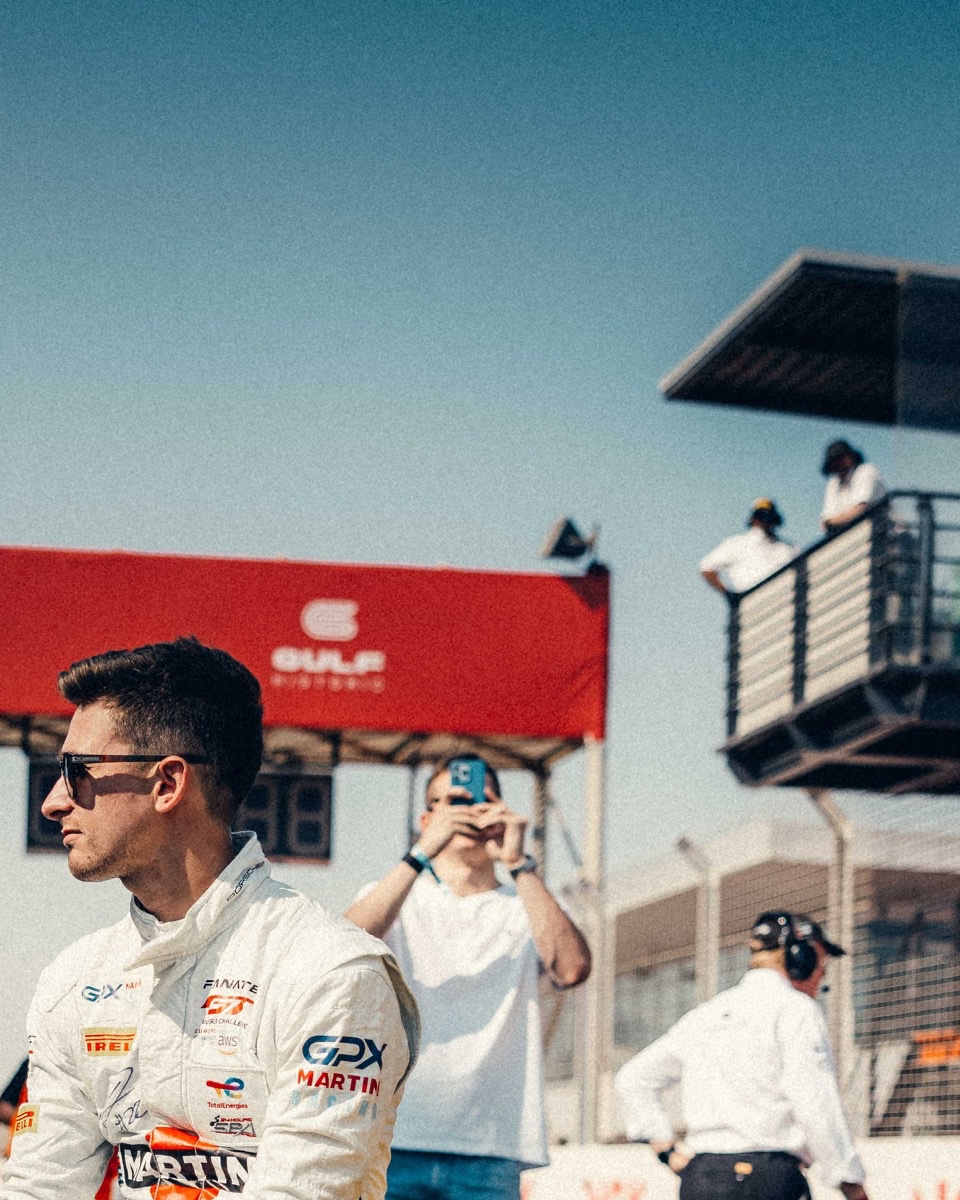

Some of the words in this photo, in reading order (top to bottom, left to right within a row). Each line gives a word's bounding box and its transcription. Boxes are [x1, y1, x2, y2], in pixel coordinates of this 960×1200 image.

[82, 984, 123, 1003] GX
[217, 1035, 239, 1047] aws
[301, 1034, 388, 1074] GPX
[297, 1068, 381, 1097] MARTIN
[207, 1101, 249, 1110] TotalEnergies
[214, 1121, 257, 1137] SPA
